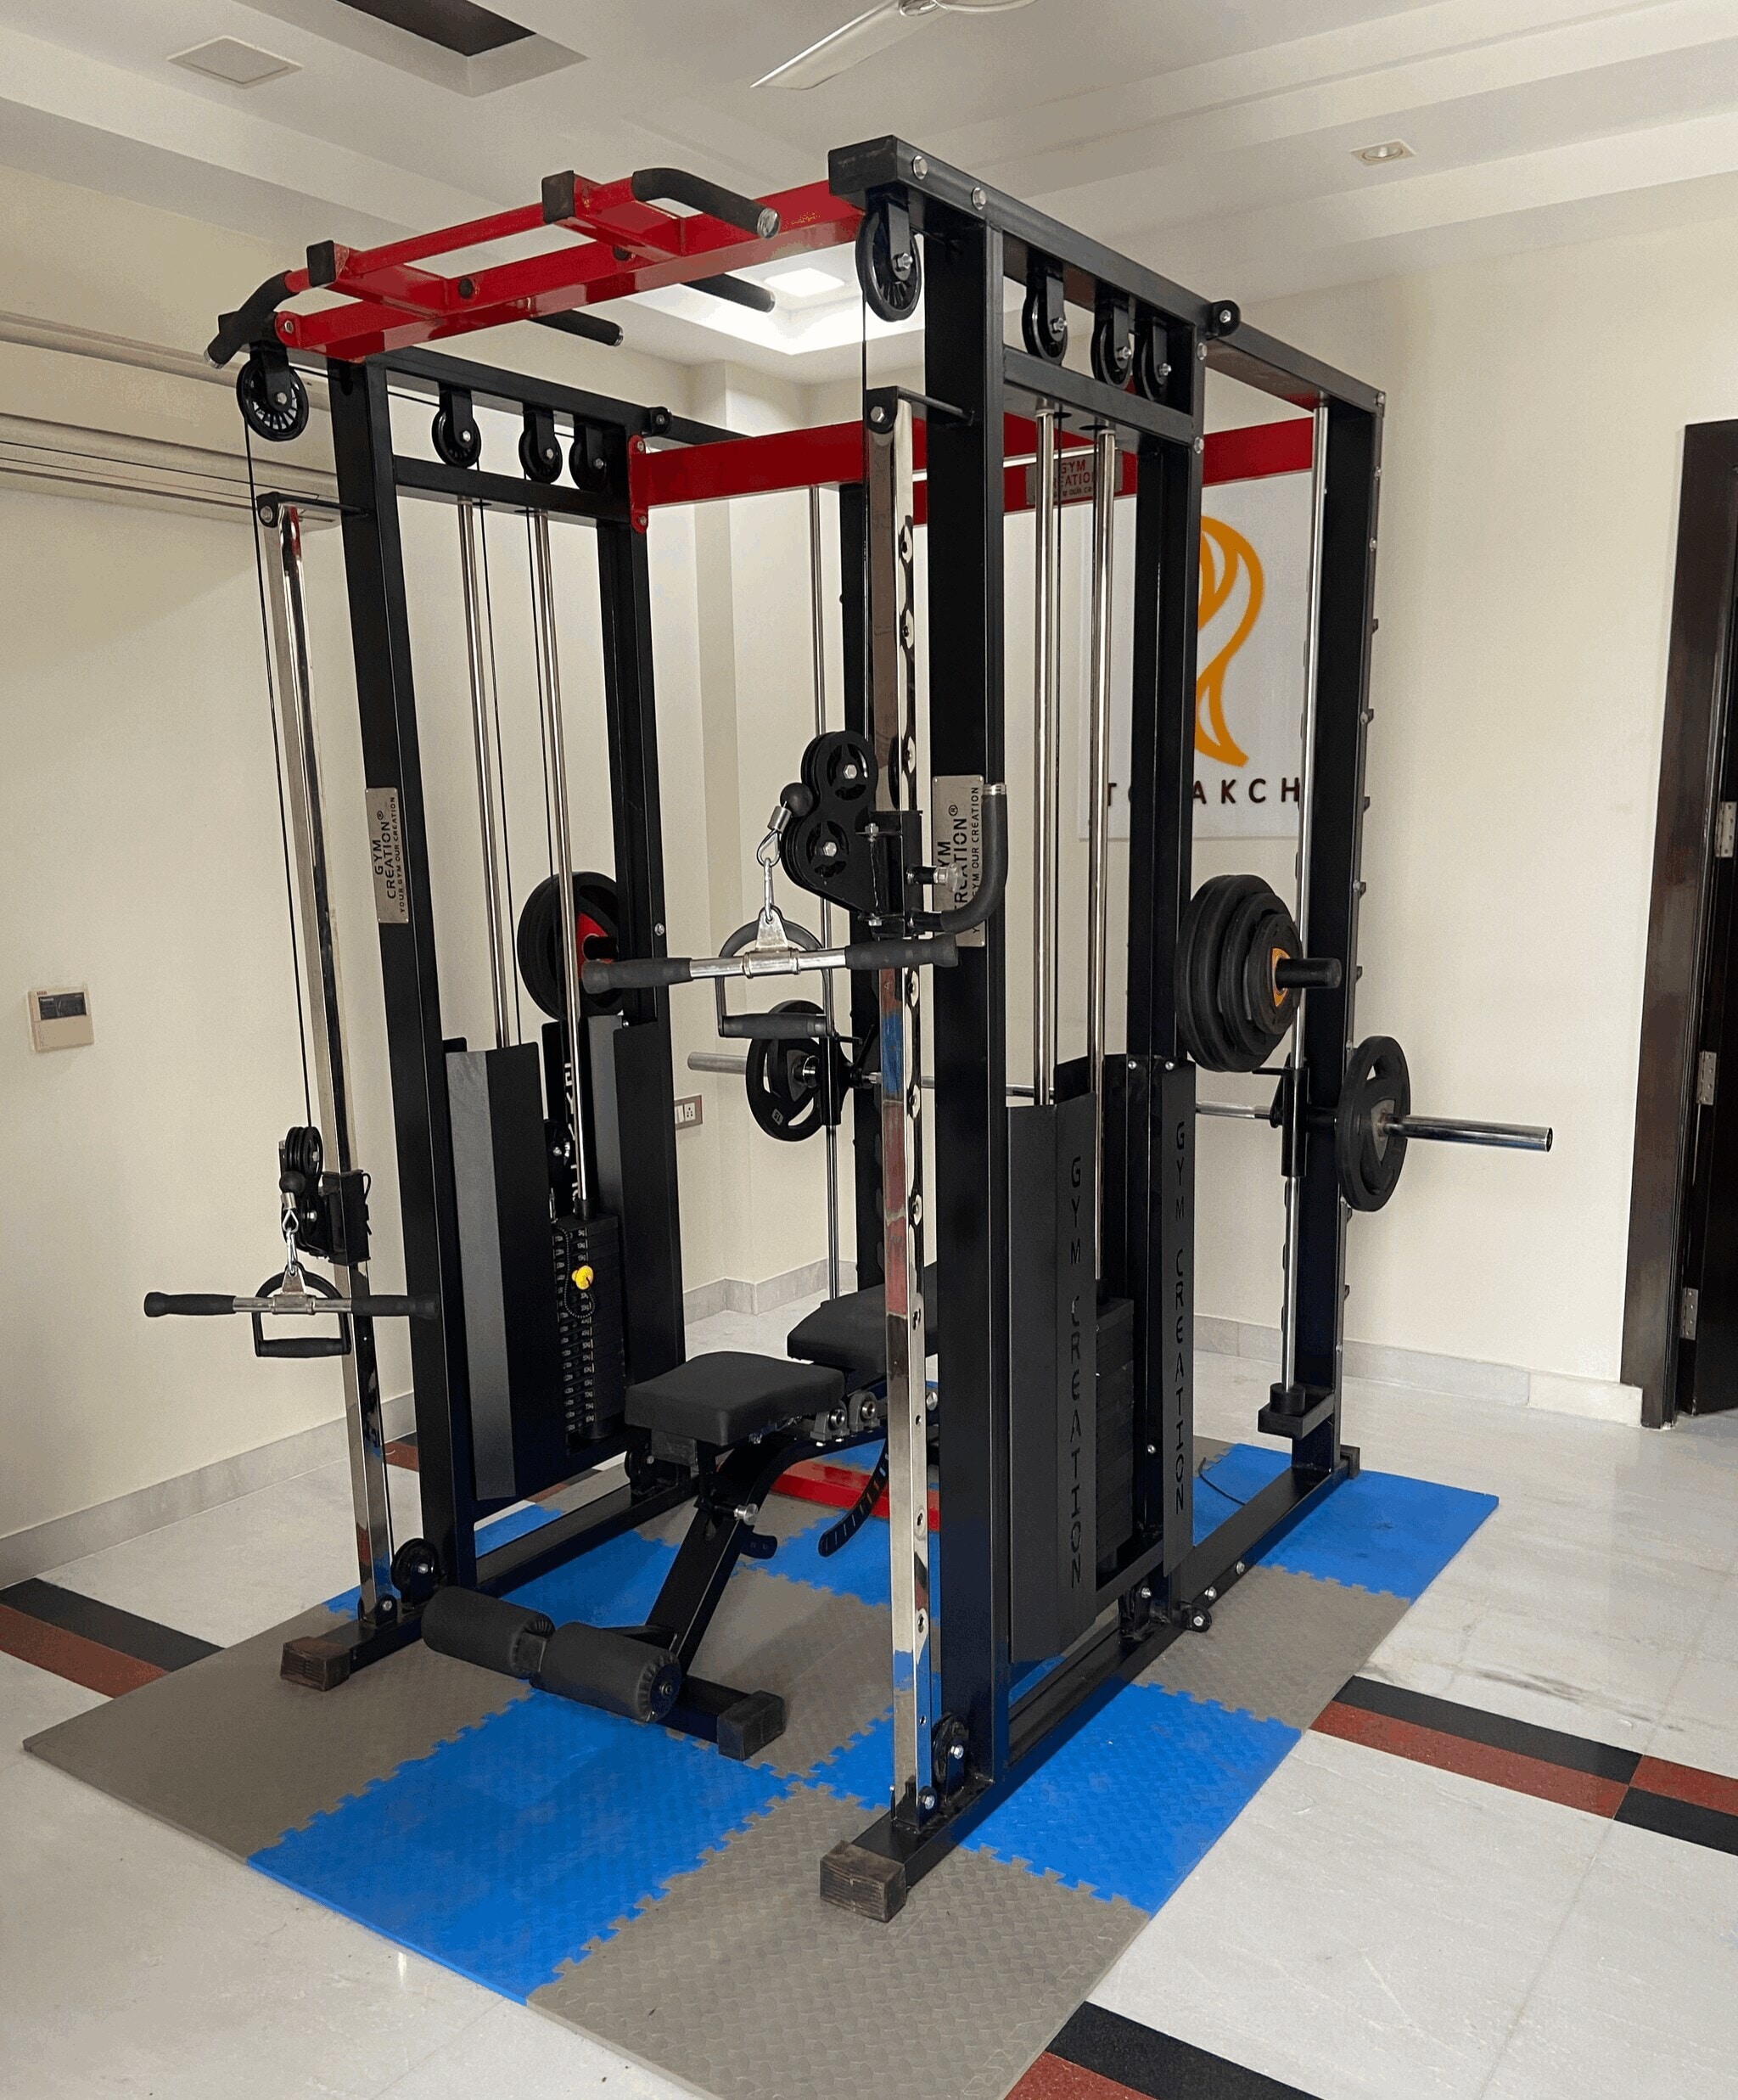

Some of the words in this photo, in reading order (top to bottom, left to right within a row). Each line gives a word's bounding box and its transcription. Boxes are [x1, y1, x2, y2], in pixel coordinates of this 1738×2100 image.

[390, 796, 399, 842] CREATION
[971, 786, 979, 843] CREATION
[373, 839, 384, 875] GYM
[937, 840, 951, 868] YM
[971, 847, 979, 868] OUR
[395, 885, 406, 913] YOUR
[1175, 1120, 1185, 1221] GYM
[1071, 1156, 1081, 1266] GYM
[1175, 1249, 1185, 1514] CREATION
[1070, 1295, 1082, 1589] CREATION
